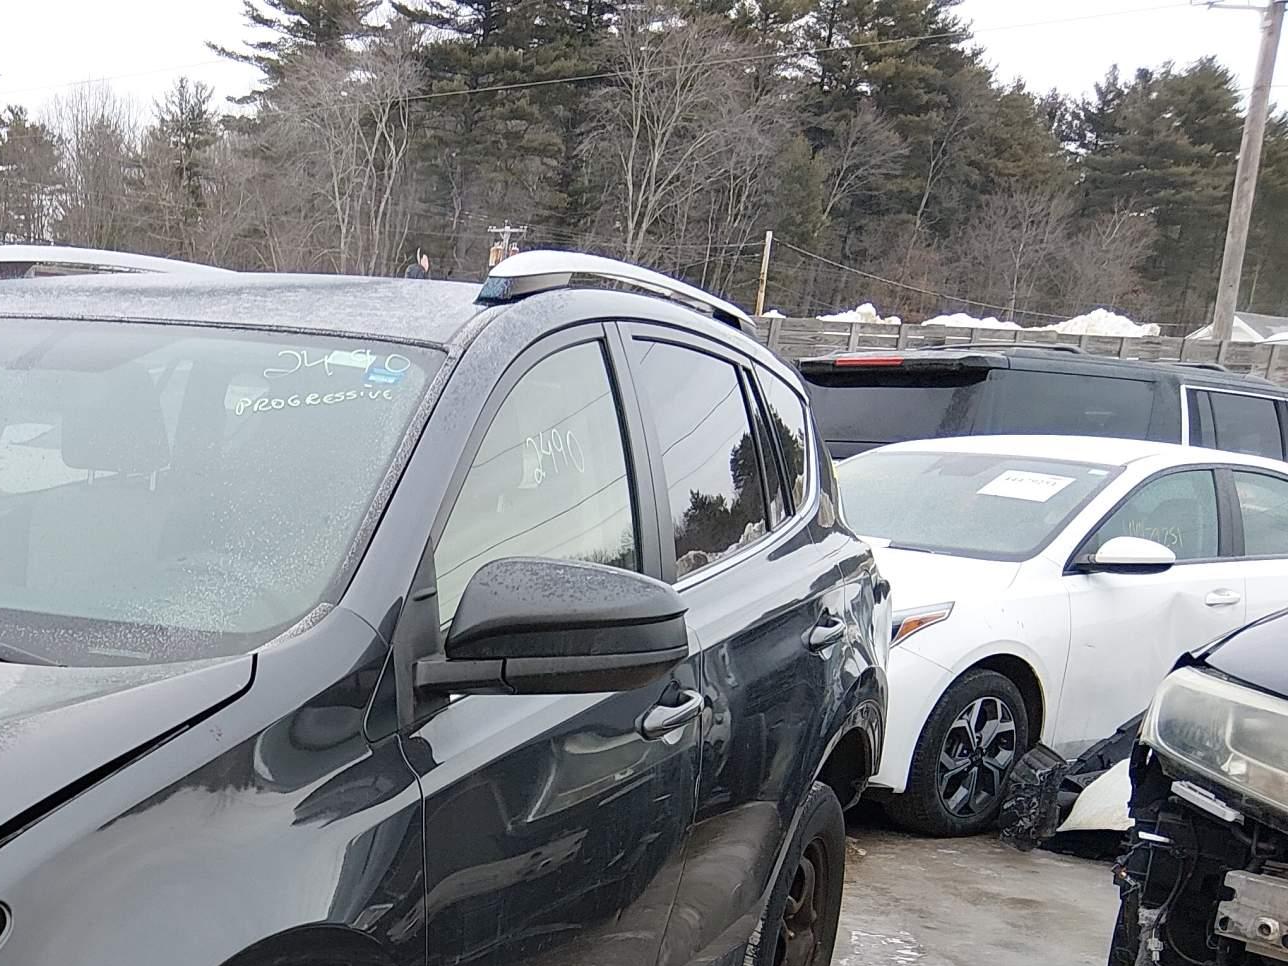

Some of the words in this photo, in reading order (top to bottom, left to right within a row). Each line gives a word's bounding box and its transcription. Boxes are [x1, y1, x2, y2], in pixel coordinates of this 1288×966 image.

[263, 349, 411, 378] 2490
[235, 383, 393, 416] PROGRESSIVE
[526, 428, 585, 484] 2490
